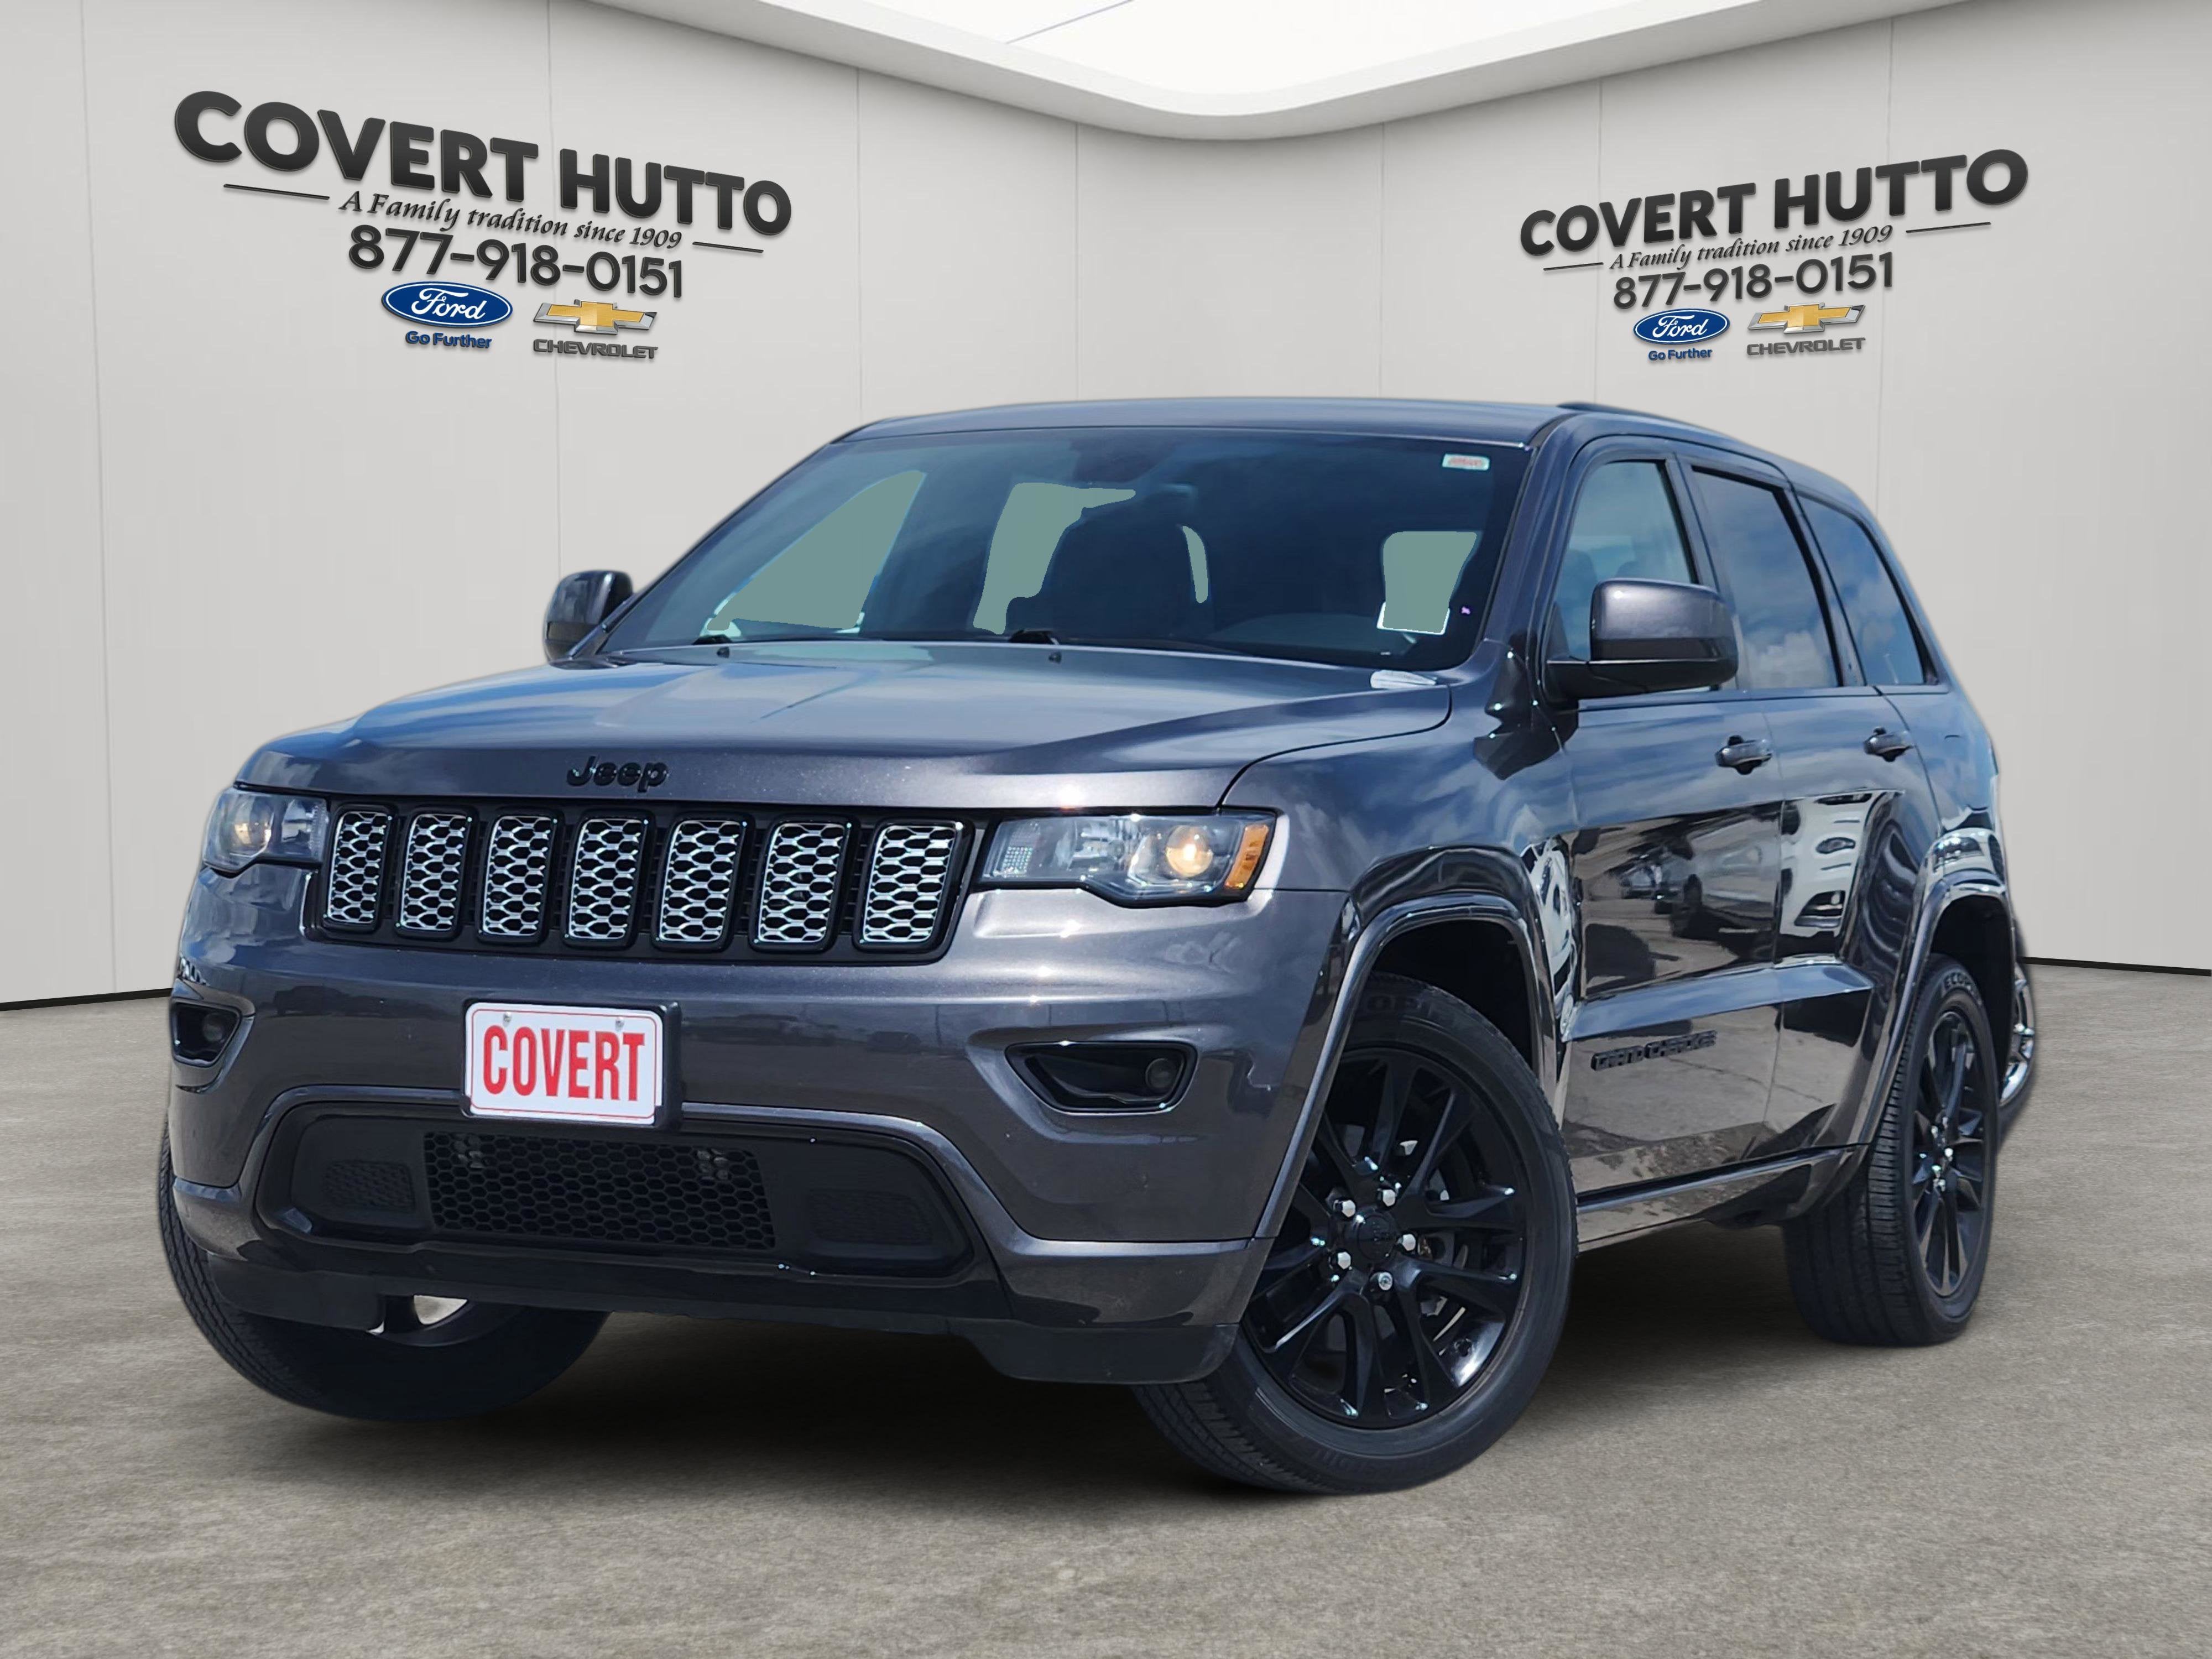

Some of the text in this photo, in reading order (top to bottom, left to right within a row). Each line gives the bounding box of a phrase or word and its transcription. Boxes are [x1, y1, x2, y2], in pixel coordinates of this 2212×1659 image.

[174, 91, 791, 236] COVERT HUTTO
[338, 190, 682, 249] A Family tradition since 1909
[1520, 149, 2028, 257] COVERT HUTTO
[348, 224, 682, 299] 877-918-0151
[1609, 225, 1893, 271] A Family tradition since 1909
[1613, 252, 1893, 310] 877-918-0151
[411, 287, 488, 320] Ford
[405, 331, 493, 349] Go Further
[1652, 315, 1709, 338] Ford
[1746, 337, 1867, 357] CHEVROLET
[533, 338, 659, 360] CHEVROLET
[1648, 347, 1714, 362] Go Further
[566, 755, 669, 793] Jeep
[483, 1025, 645, 1101] COVERT
